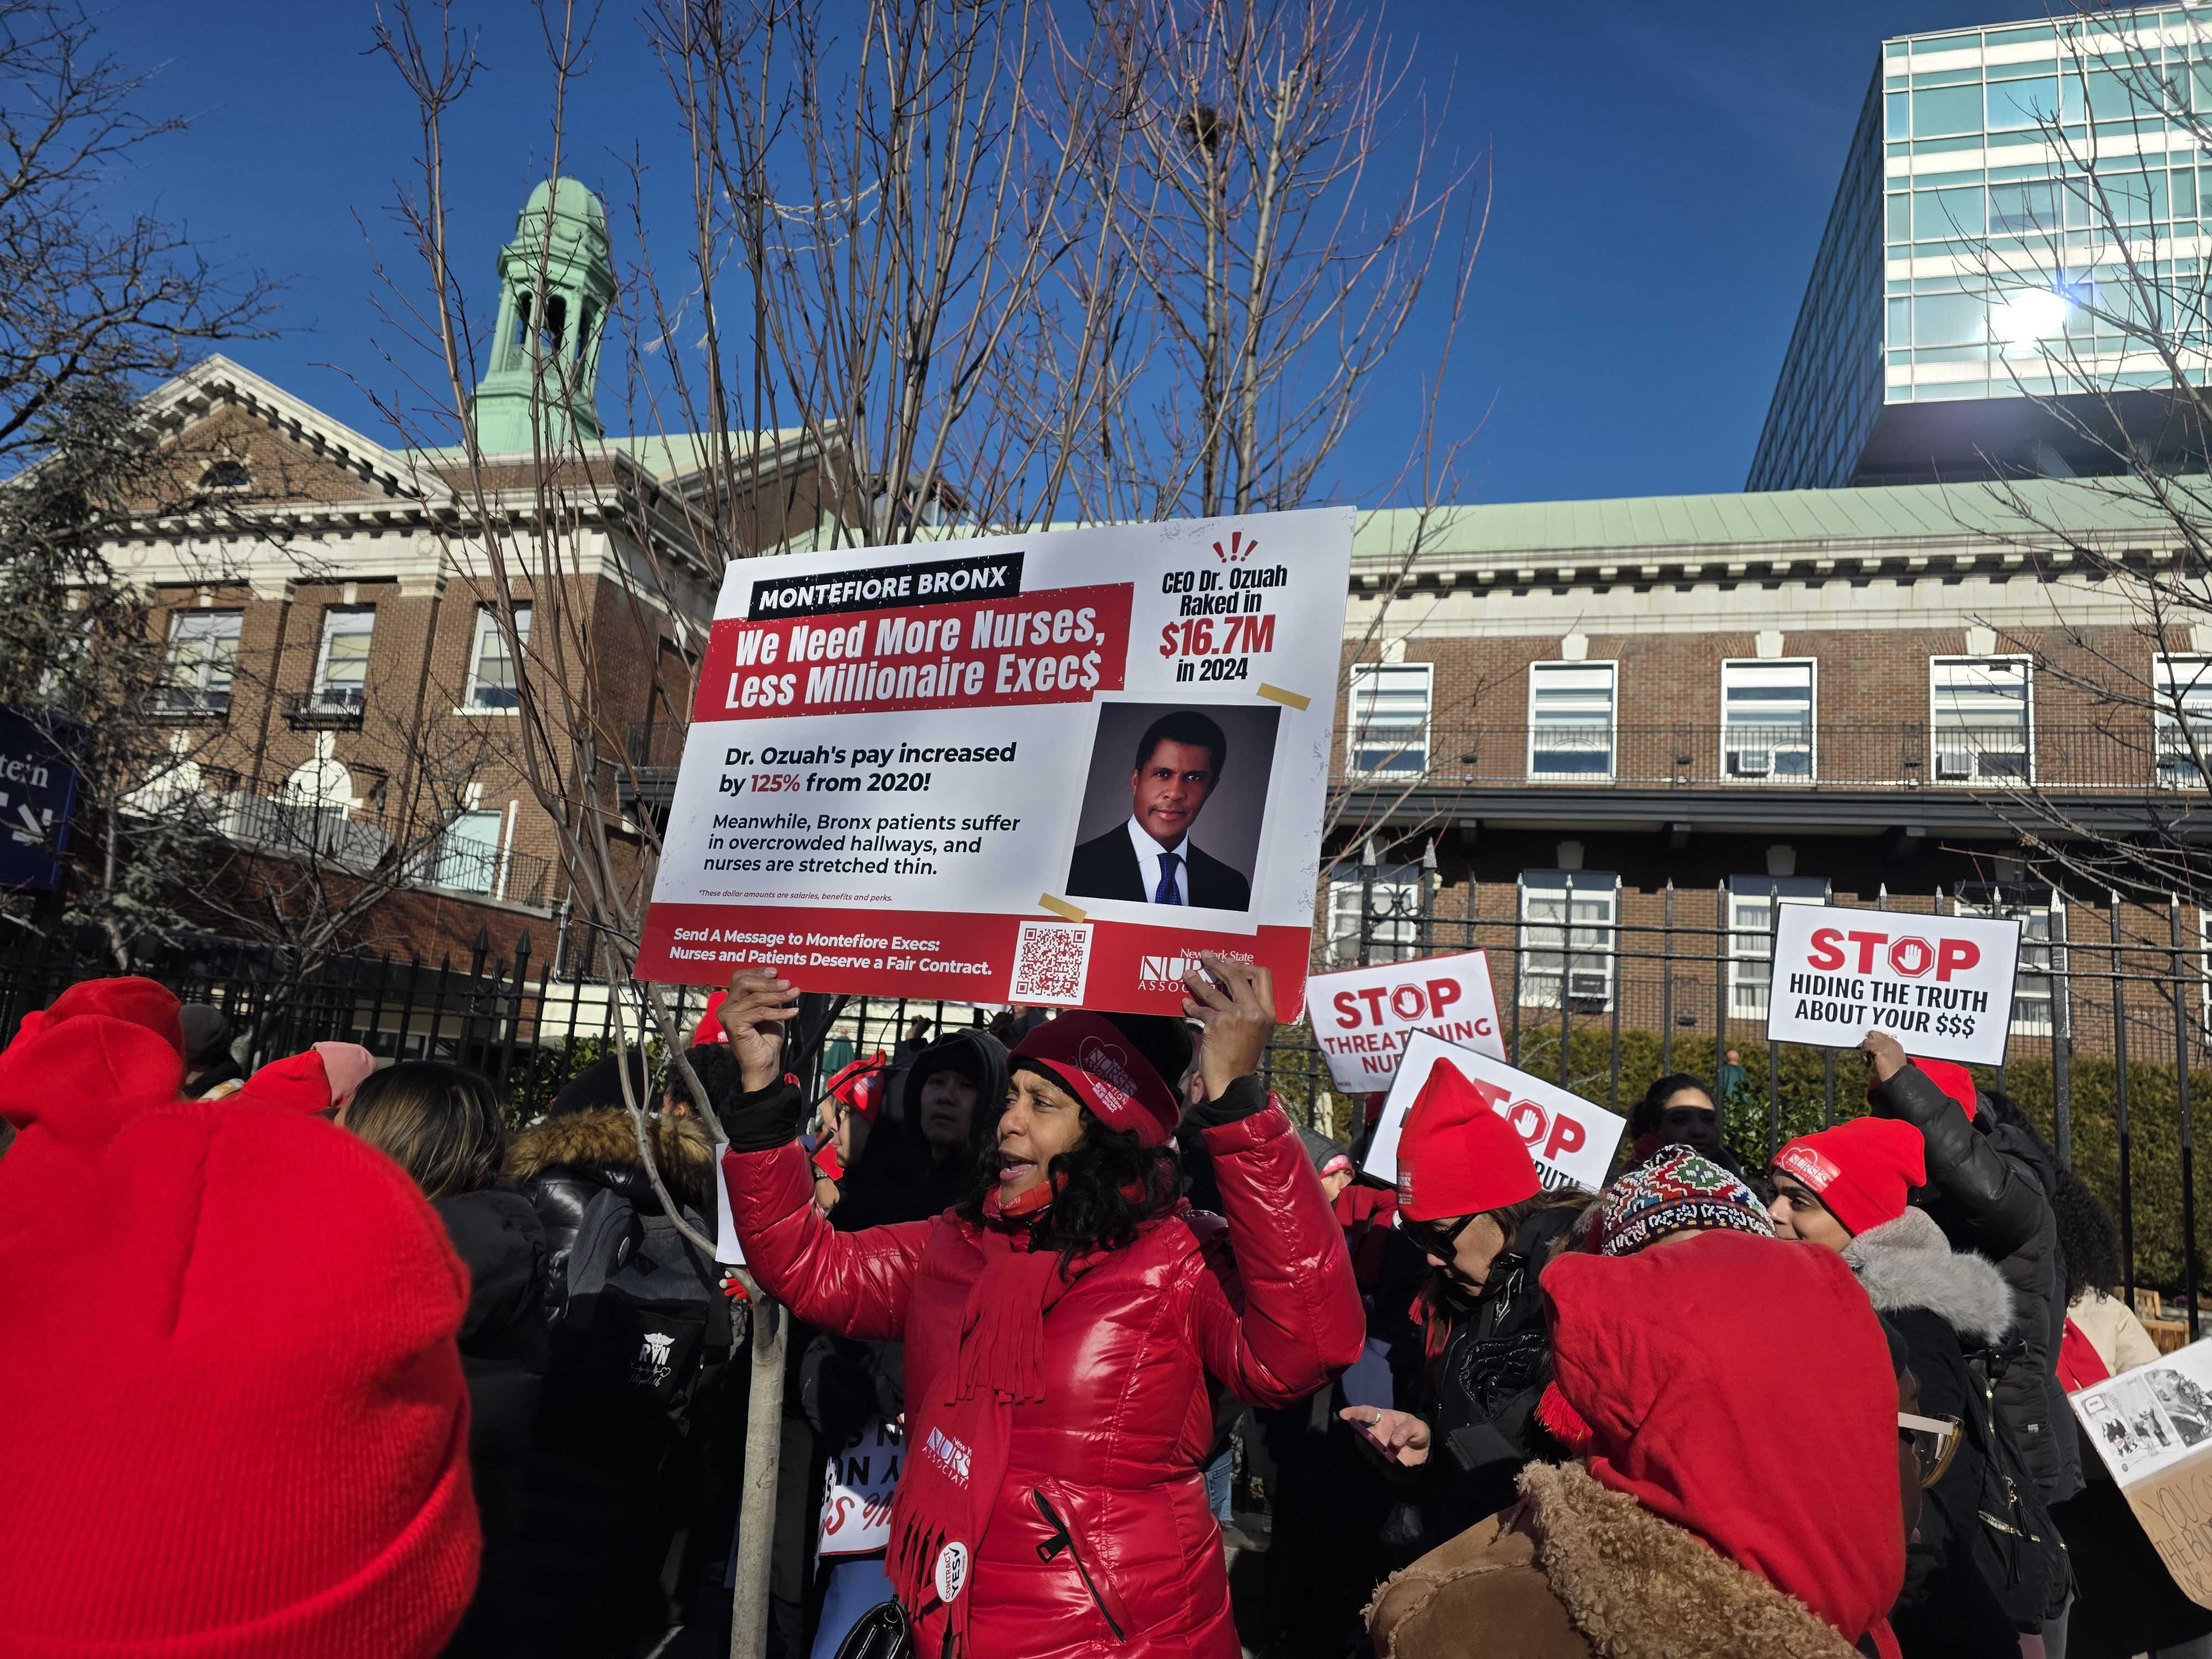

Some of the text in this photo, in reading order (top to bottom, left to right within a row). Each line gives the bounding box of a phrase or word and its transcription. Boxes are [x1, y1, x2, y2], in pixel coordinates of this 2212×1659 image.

[759, 565, 1008, 611] MONTEFIORE BRONX
[1162, 565, 1287, 593] CEO Dr. Ozuah
[1180, 590, 1262, 616] Raked in
[736, 607, 1105, 666] We Need More Nurses,
[1160, 614, 1276, 659] $16.7M
[726, 650, 1102, 709] Less Millionaire Exec$
[1176, 658, 1248, 682] in 2024
[725, 742, 1017, 768] Dr. Ozuah's pay increased
[719, 772, 931, 796] by 125% from 2020!
[713, 813, 1021, 833] Meanwhile, Bronx patients suffer
[708, 834, 982, 856] in overcrowded hallways, and
[703, 856, 938, 875] nurses are stretched thin.
[790, 891, 820, 900] salaries,
[821, 892, 853, 901] benefits
[870, 894, 893, 902] perks.
[674, 927, 940, 952] Send A Message to Montefiore Execs:
[1180, 948, 1254, 962] New ork State
[1807, 927, 1980, 982] STOP
[669, 946, 992, 976] Nurses and Patients Deserve a Fair Contract.
[1333, 978, 1462, 1029] STOP
[1790, 973, 1988, 1013] HIDING THE TRUTH
[1324, 1018, 1491, 1055] THREATNING
[1794, 999, 1976, 1039] ABOUT YOUR $$$
[1473, 1077, 1587, 1161] TOP
[922, 1446, 968, 1490] ASSOCIATI
[2140, 1484, 2198, 1533] YOU
[951, 1557, 961, 1599] YES
